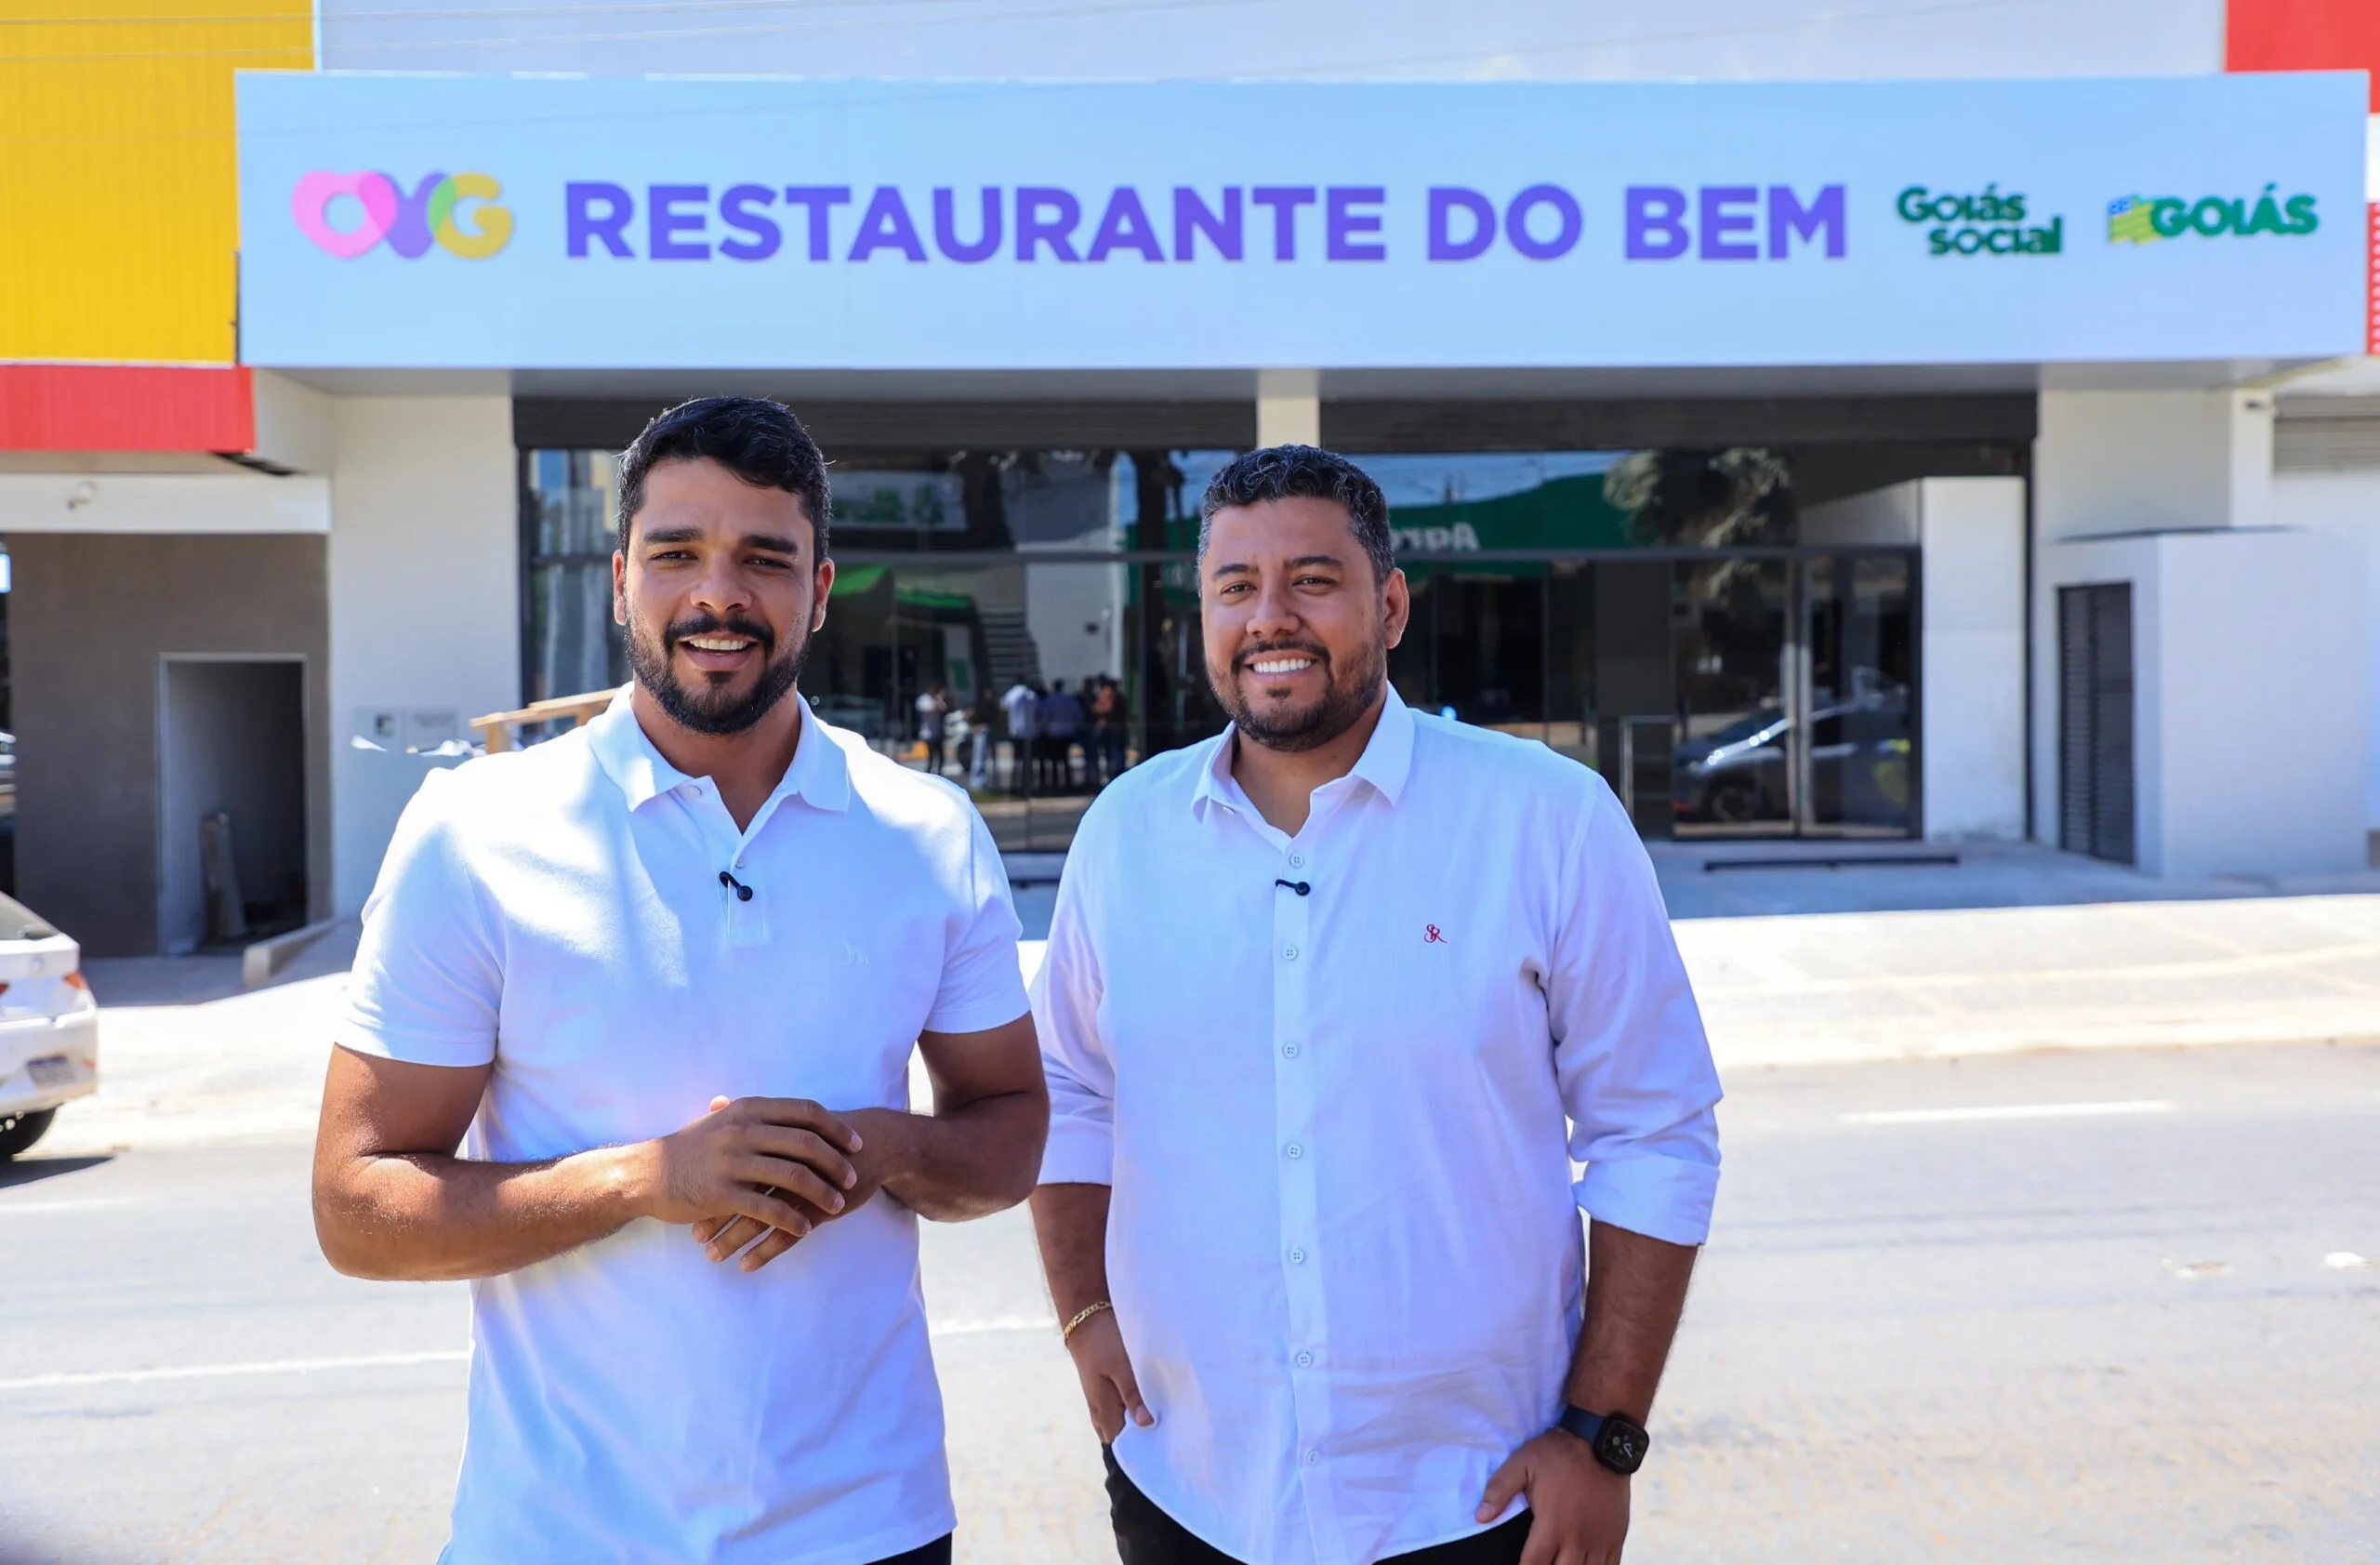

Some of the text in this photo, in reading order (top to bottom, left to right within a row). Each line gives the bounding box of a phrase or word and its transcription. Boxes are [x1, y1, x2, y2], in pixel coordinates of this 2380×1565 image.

[565, 181, 1846, 263] RESTAURANTE DO BEM
[1896, 182, 2027, 222] Goiás
[2150, 182, 2320, 237] GOIÁS
[1928, 216, 2062, 255] social
